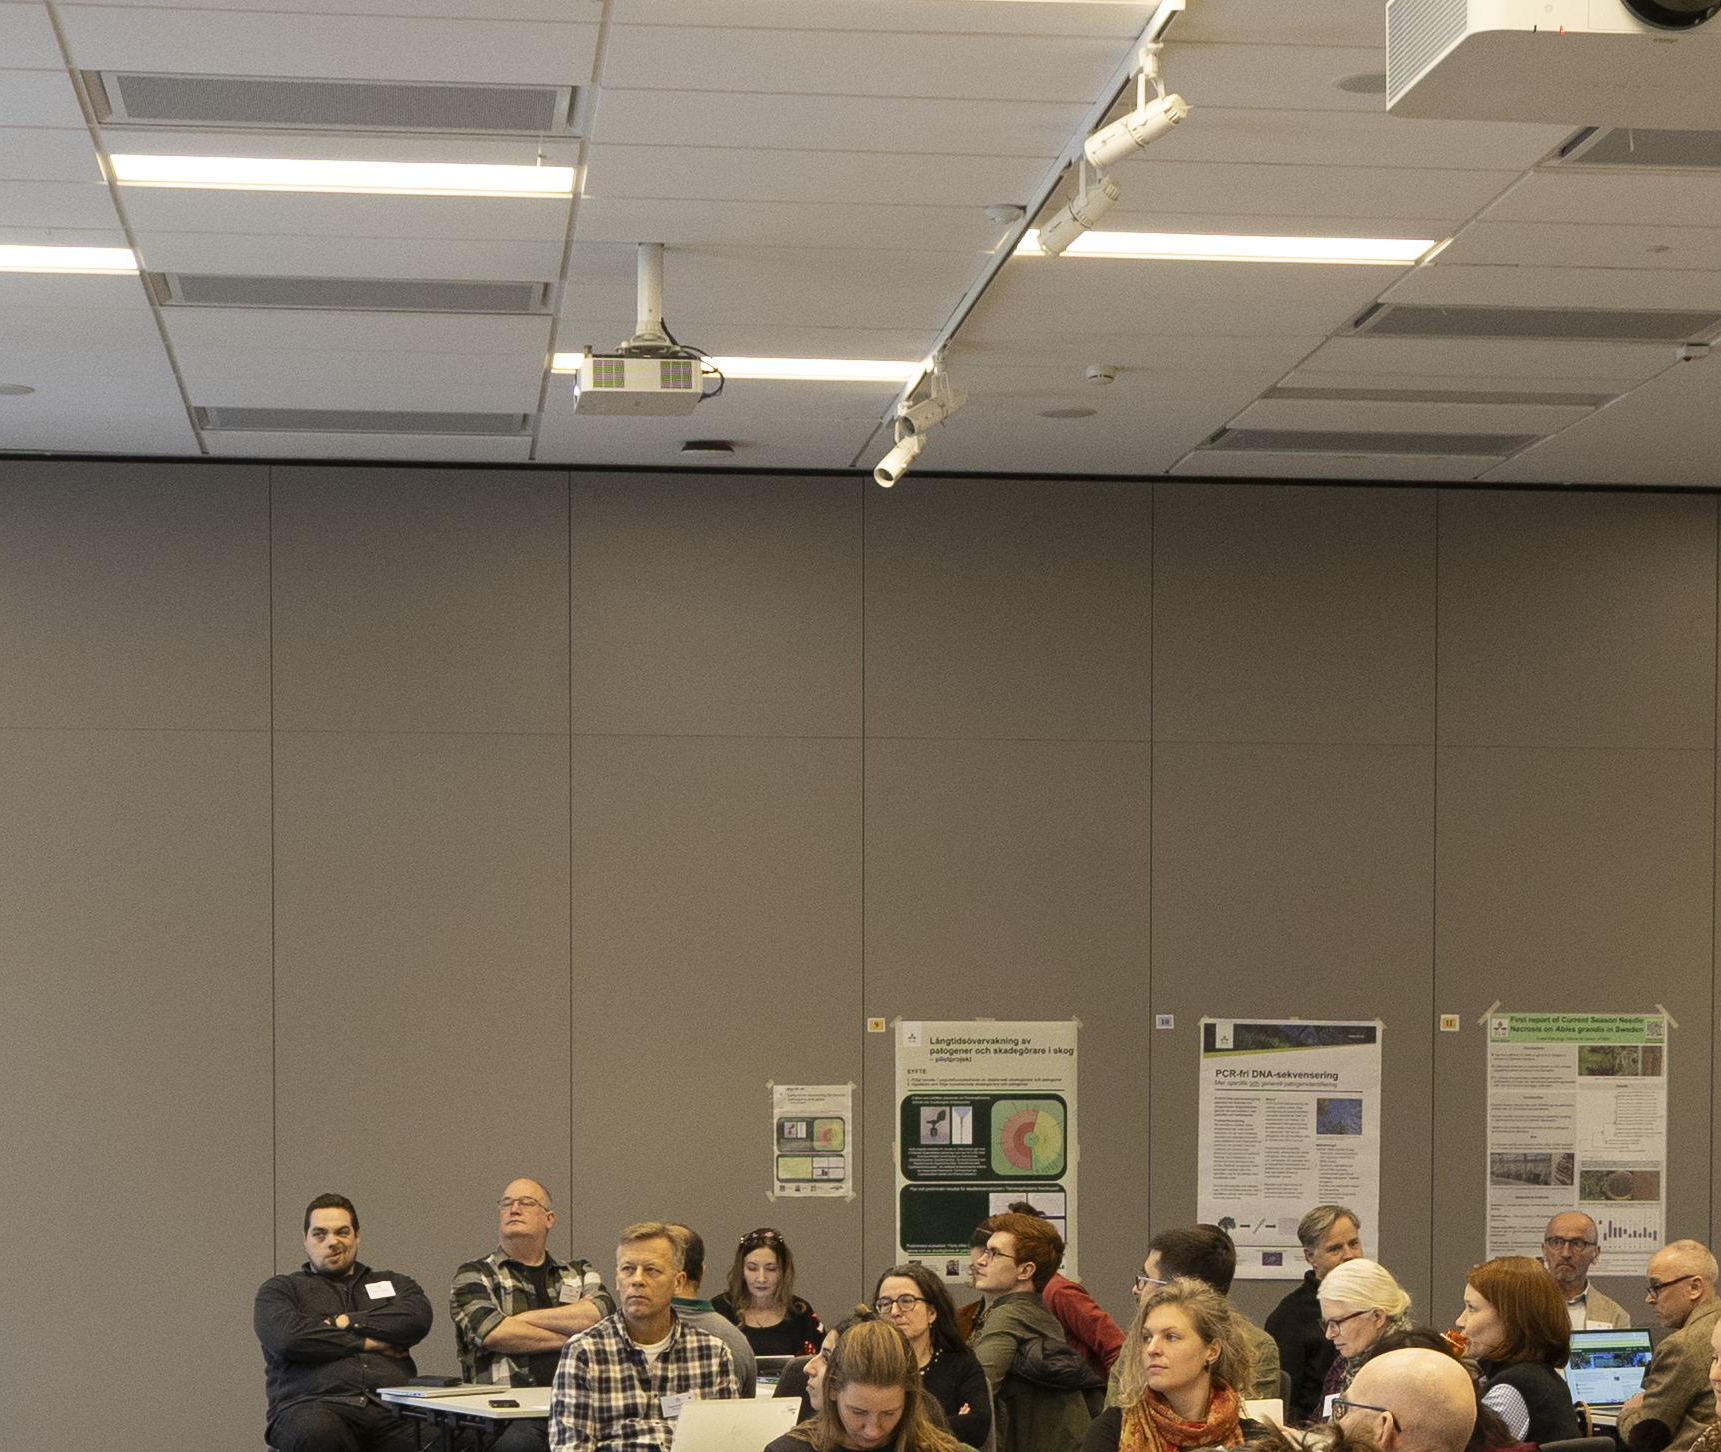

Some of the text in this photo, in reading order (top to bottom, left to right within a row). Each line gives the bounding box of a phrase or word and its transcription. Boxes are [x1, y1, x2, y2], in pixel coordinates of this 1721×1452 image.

[1160, 1018, 1170, 1026] 10
[1445, 1019, 1453, 1027] 11
[1555, 1025, 1576, 1033] Abies
[1578, 1026, 1605, 1035] grandis
[930, 1036, 1019, 1046] Långtidsövervakning
[930, 1048, 973, 1056] patogener
[975, 1047, 991, 1055] och
[993, 1047, 1046, 1056] skadegörare
[1053, 1047, 1074, 1056] skog
[1215, 1069, 1339, 1081] PCR-fri DNA-sekvensering
